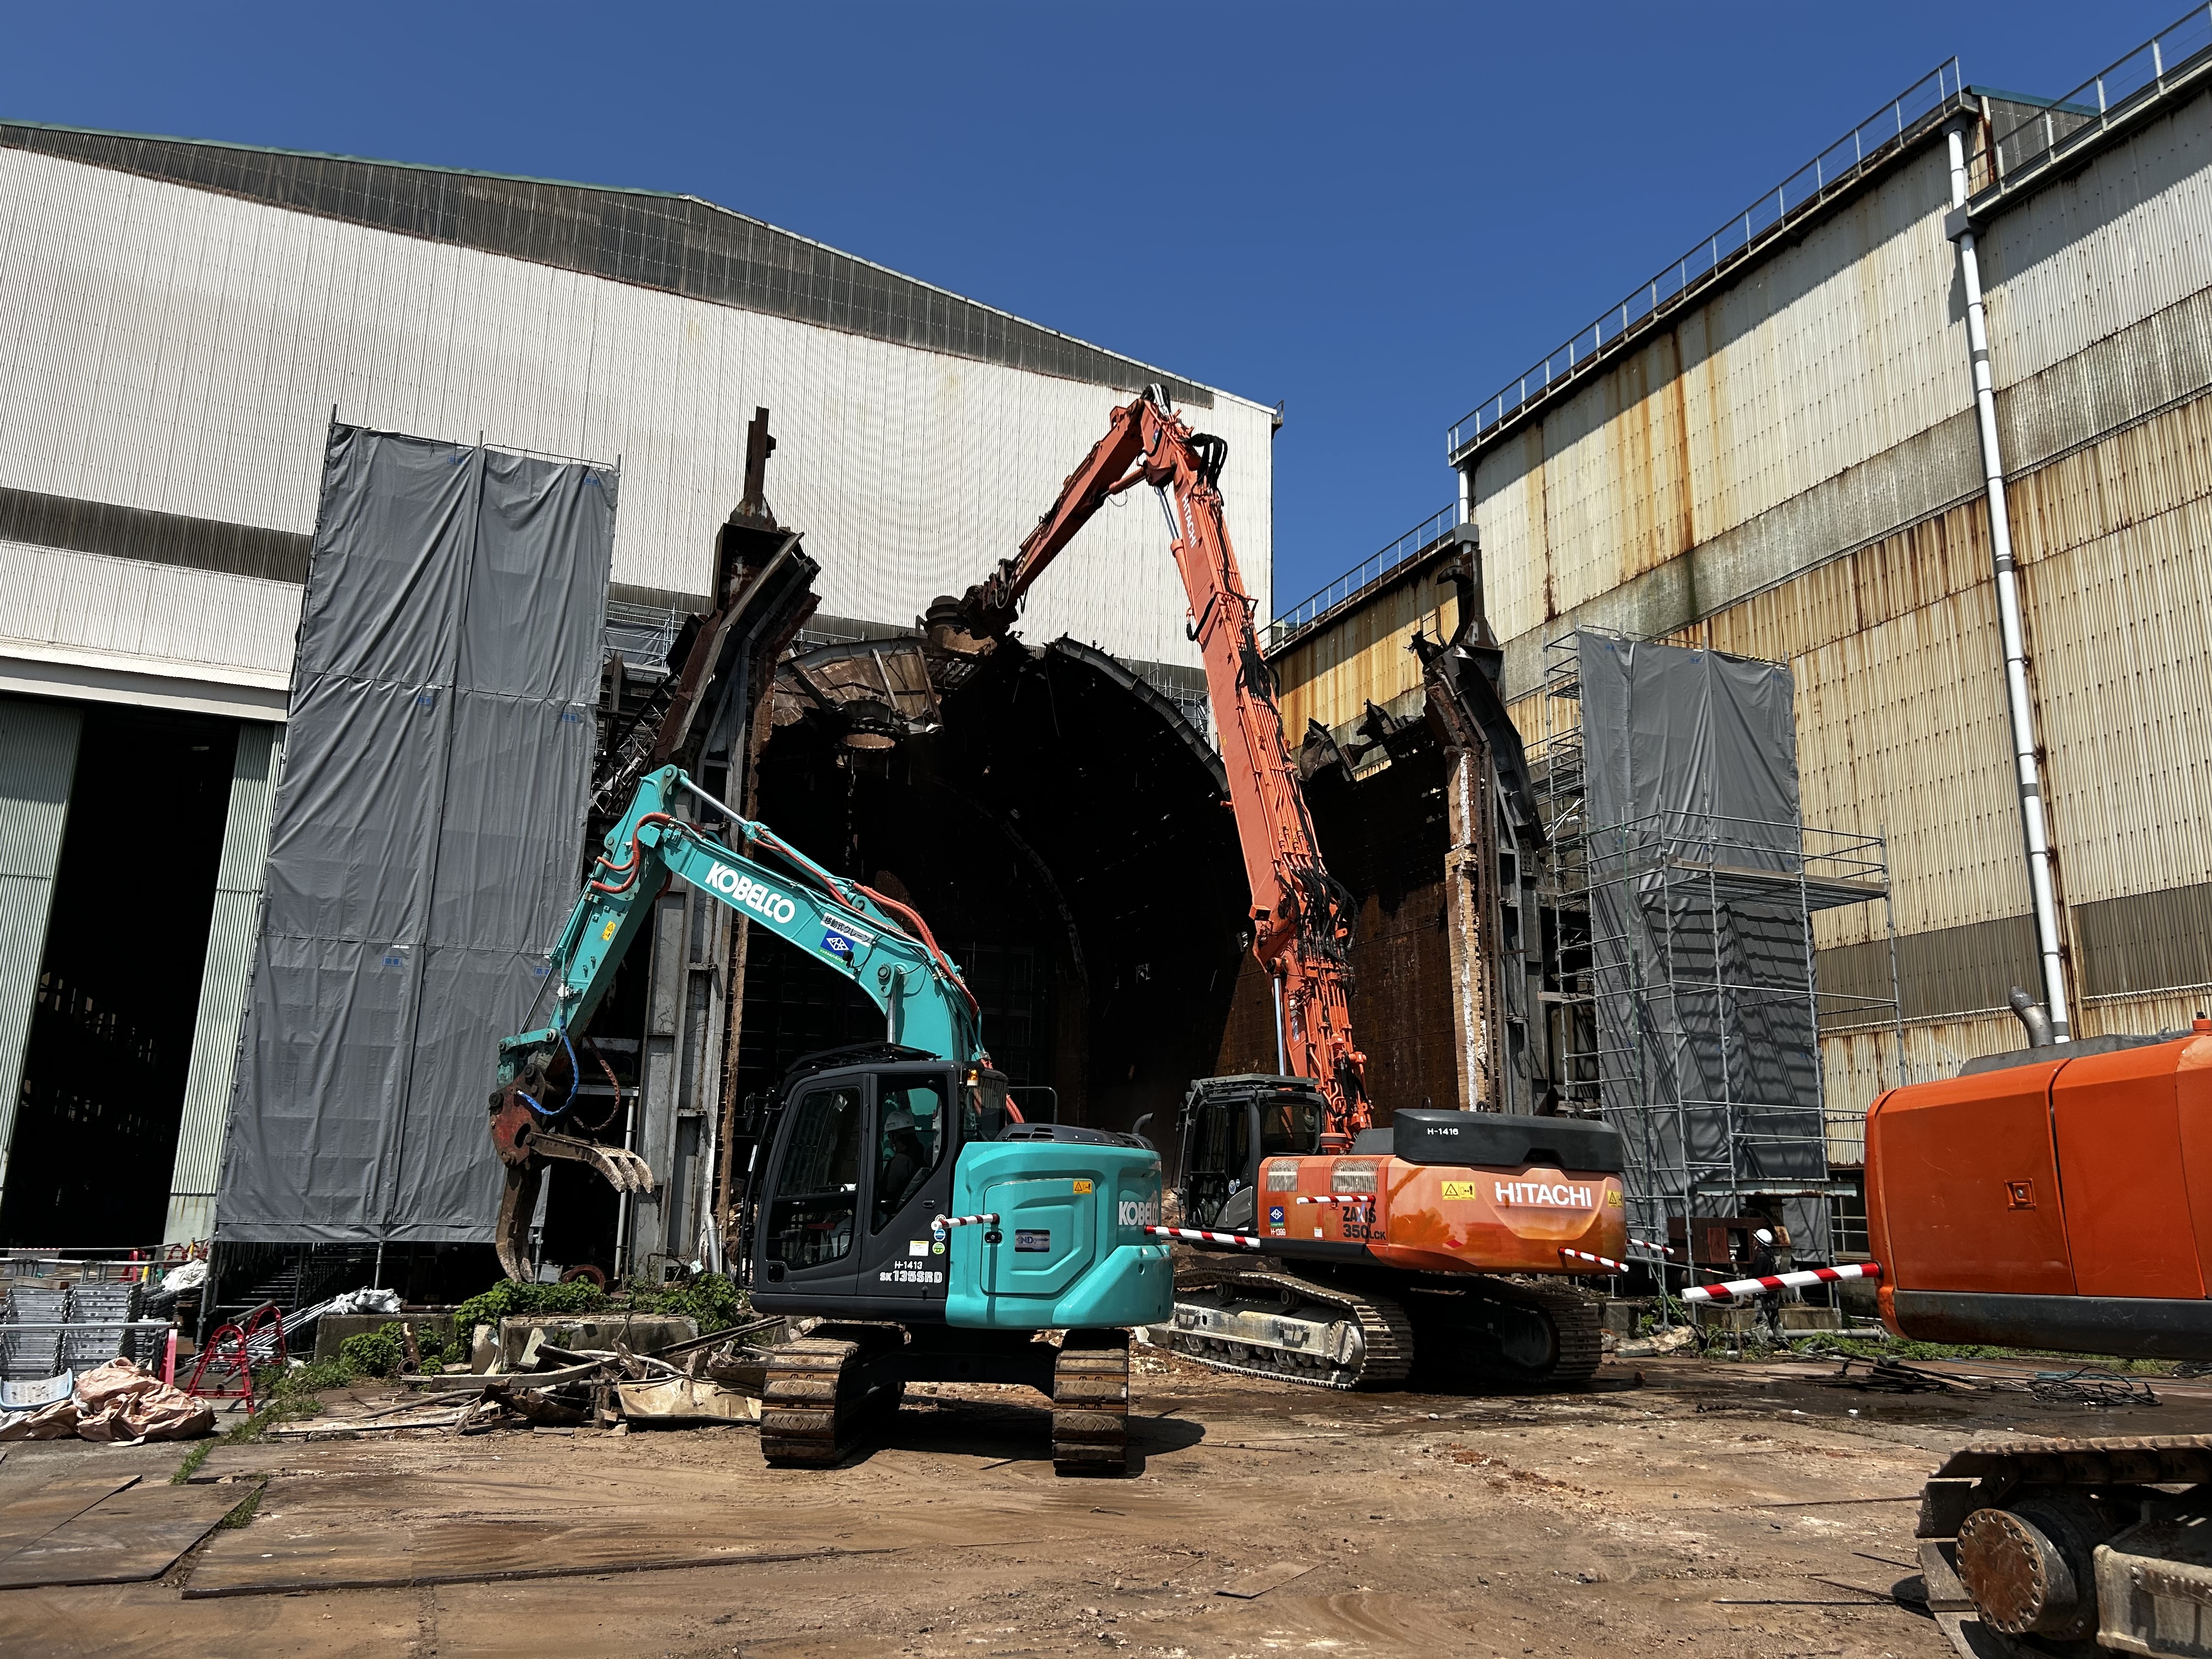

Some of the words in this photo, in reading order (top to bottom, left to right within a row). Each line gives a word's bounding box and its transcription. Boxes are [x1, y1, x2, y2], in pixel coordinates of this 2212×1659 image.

[1182, 493, 1197, 548] HITACHI
[704, 861, 795, 923] KOBELCO
[824, 916, 870, 942] 移動式クレーン
[1495, 1181, 1592, 1206] HITACHI
[1119, 1201, 1159, 1225] KOBELCO
[1342, 1203, 1376, 1223] ZAXIS
[879, 1270, 943, 1283] SK135SRD
[894, 1261, 923, 1269] H-1413
